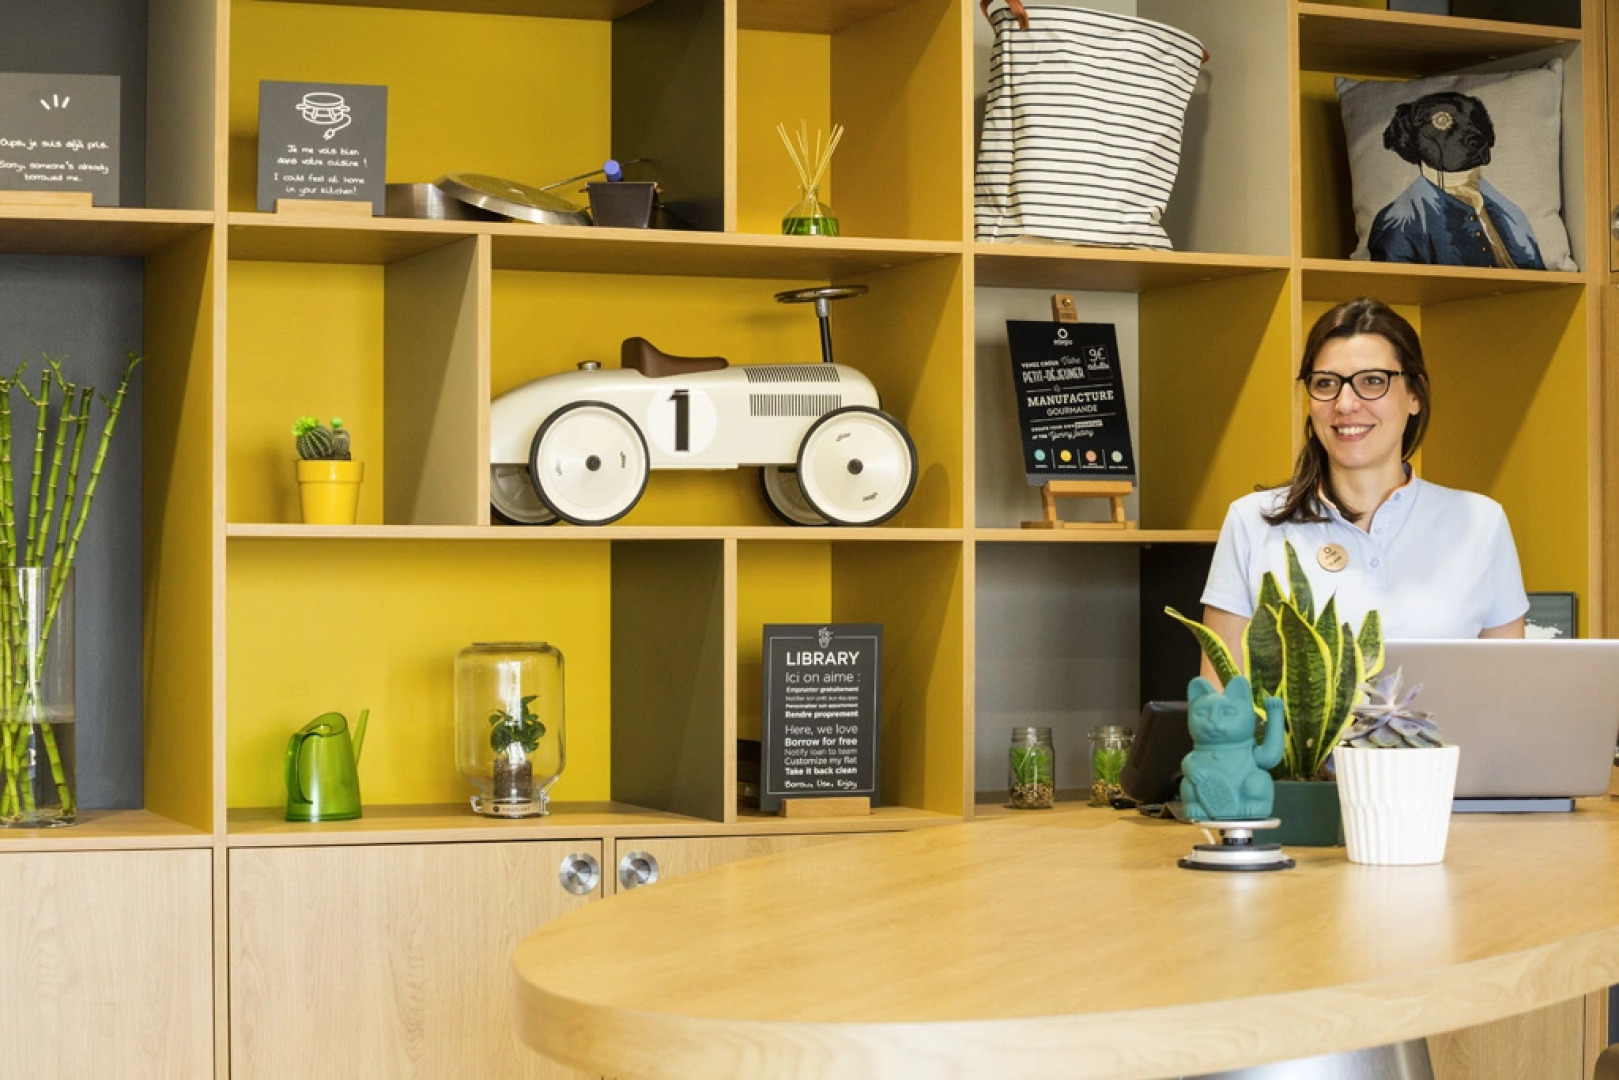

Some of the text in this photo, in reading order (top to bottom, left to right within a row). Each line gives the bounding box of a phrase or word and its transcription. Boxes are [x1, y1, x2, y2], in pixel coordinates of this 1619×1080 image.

[27, 139, 38, 150] je
[41, 140, 62, 148] suis
[287, 144, 298, 153] Je
[318, 147, 337, 155] vois
[340, 147, 359, 156] bien
[29, 160, 75, 170] someone's
[78, 163, 110, 174] already
[277, 157, 297, 165] dans
[302, 157, 323, 166] votre
[327, 158, 359, 167] cuisine
[24, 173, 63, 181] borrowed
[274, 172, 365, 185] I could feel at home
[299, 187, 317, 197] your
[320, 186, 357, 195] kitchen!
[1026, 390, 1114, 407] MANUFACTURE
[1046, 404, 1098, 417] GOURMANDE
[667, 388, 690, 453] 1
[786, 651, 860, 666] LIBRARY
[785, 671, 800, 683] Ici
[803, 672, 820, 683] on
[823, 671, 854, 683] aime
[785, 709, 859, 719] Rendre proprement
[785, 723, 858, 735] Here, we love
[784, 736, 858, 747] Borrow for free
[784, 748, 808, 757] Notify
[809, 748, 827, 756] loan
[784, 756, 858, 766] Customize my flat
[784, 766, 858, 776] Take it back clean
